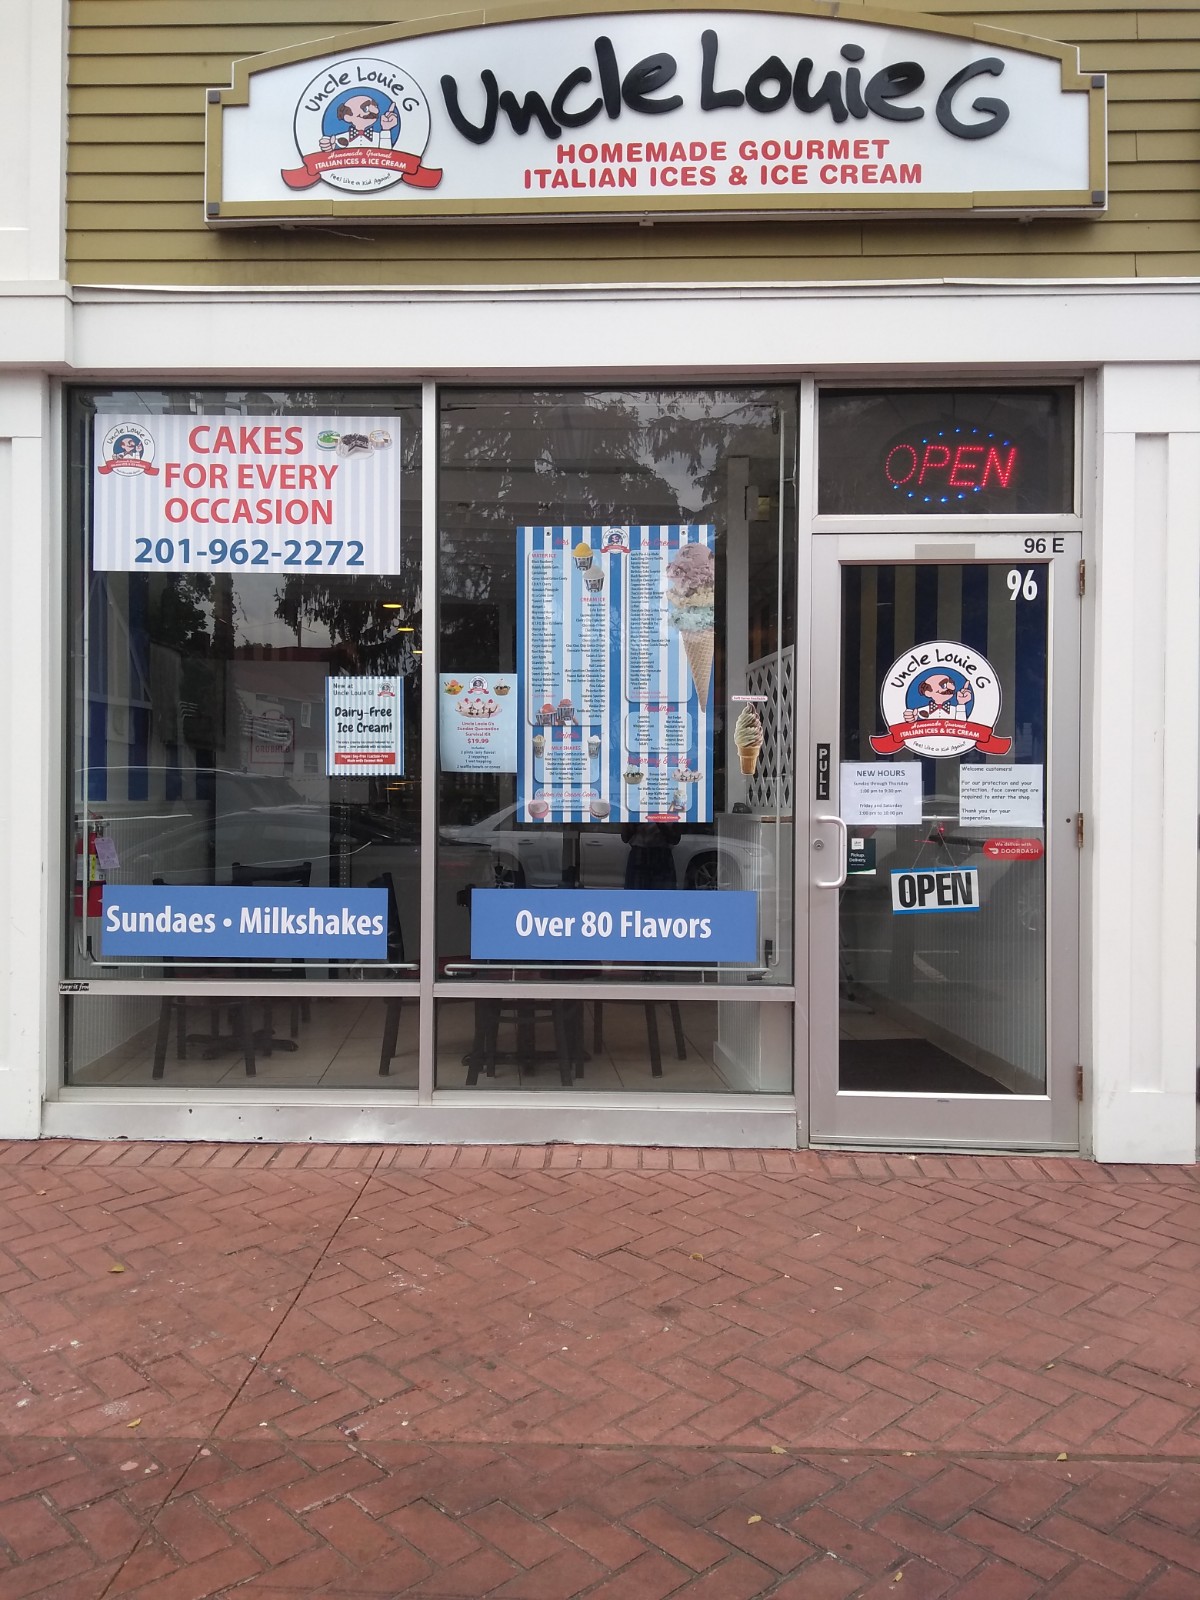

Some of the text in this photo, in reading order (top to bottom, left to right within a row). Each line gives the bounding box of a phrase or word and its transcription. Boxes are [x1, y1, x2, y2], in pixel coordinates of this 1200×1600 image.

[305, 66, 420, 112] Uncle Louie G
[440, 29, 1010, 144] Uncle Louie G
[315, 160, 343, 170] ITALIAN
[381, 159, 407, 169] CREAM
[328, 149, 393, 159] Homemade Gourmet
[556, 139, 890, 165] HOMEMADE GOURMET
[524, 163, 922, 189] ITALIAN ICES & ICE CREAM
[107, 428, 124, 445] Uncle
[188, 425, 304, 455] CAKES
[165, 463, 339, 490] FOR EVERY
[885, 444, 1017, 488] OPEN
[164, 497, 333, 525] OCCASION
[135, 537, 365, 566] 201-962-2272
[1024, 537, 1065, 554] 96 E
[1006, 569, 1038, 601] 96
[891, 649, 991, 689] Uncle Louie G
[335, 706, 392, 720] Dairy-Free
[911, 720, 942, 729] Homemade
[337, 722, 392, 733] Ice Cream!
[900, 729, 924, 737] ITALIAN
[957, 729, 980, 737] CREAM
[819, 748, 828, 796] PULL
[877, 769, 906, 777] HOURS
[898, 872, 973, 908] OPEN
[106, 905, 383, 936] Sundaes Milkshakes
[515, 909, 712, 939] Over 80 Flavors
